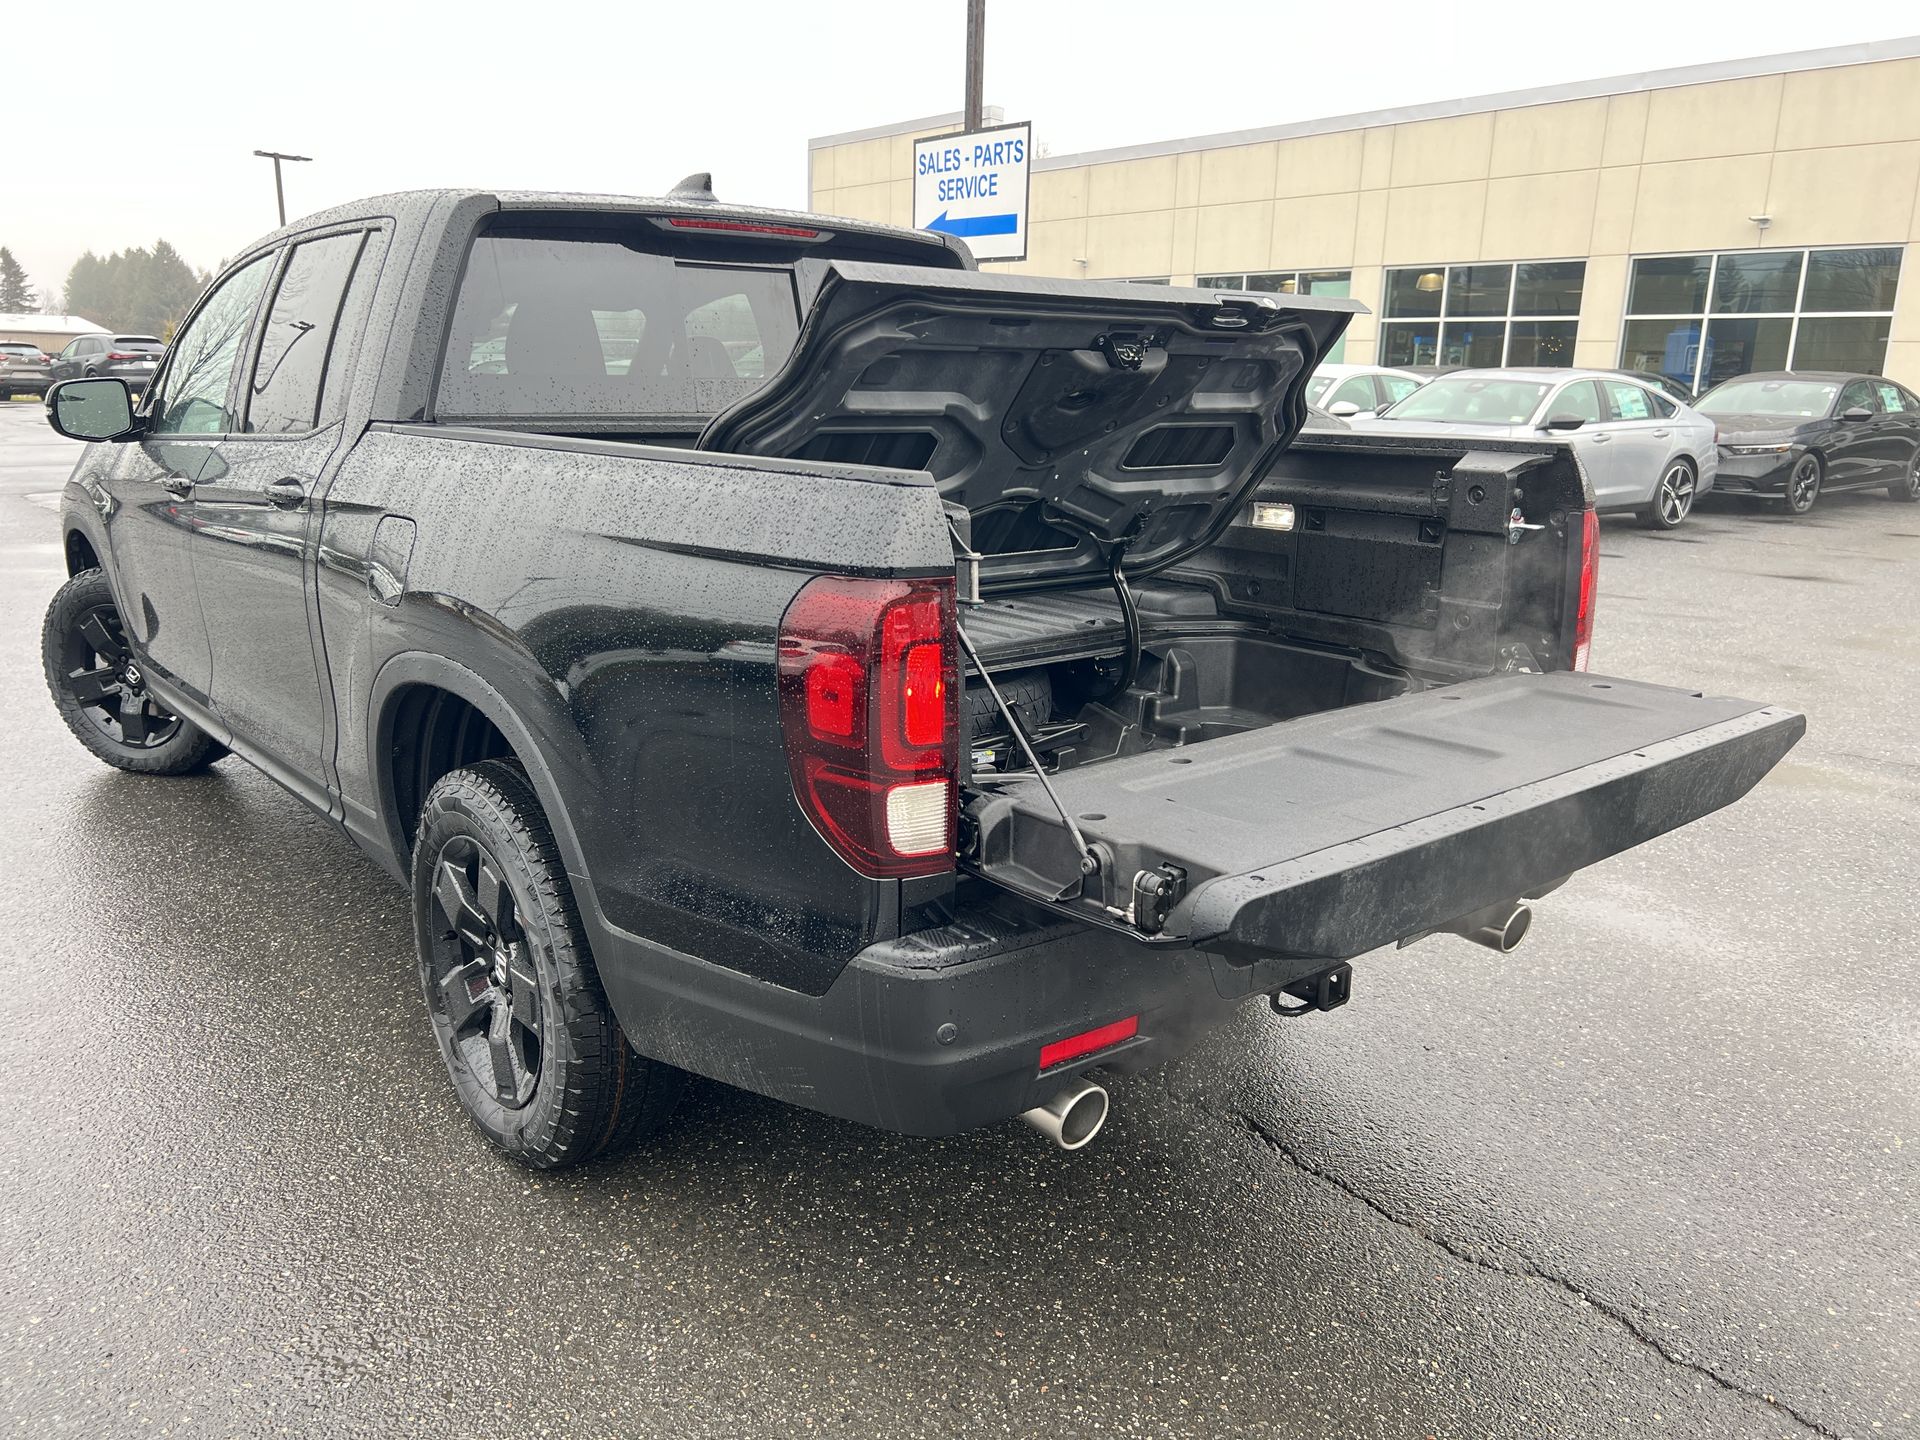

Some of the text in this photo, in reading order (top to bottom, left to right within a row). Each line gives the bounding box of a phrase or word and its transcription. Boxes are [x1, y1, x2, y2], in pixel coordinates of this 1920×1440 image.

[918, 148, 961, 176] SALES
[974, 139, 1024, 168] PARTS
[938, 173, 998, 202] SERVICE
